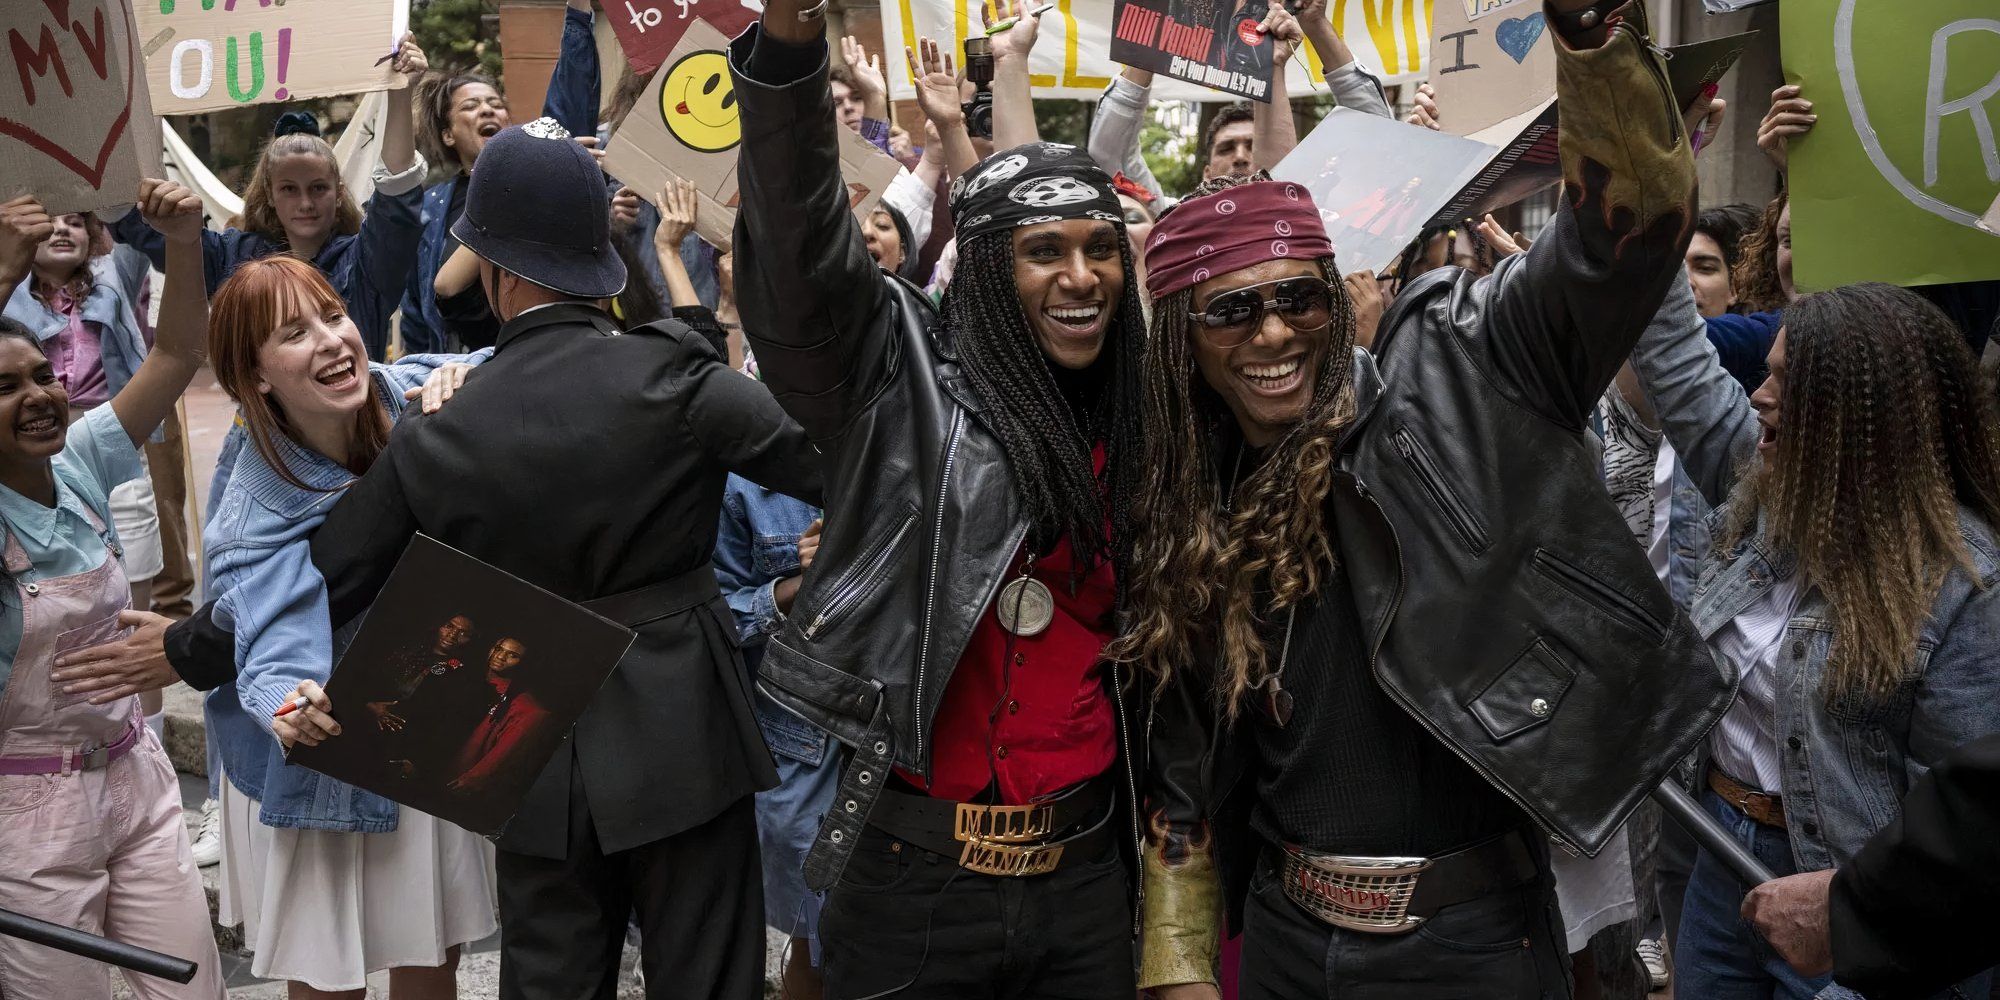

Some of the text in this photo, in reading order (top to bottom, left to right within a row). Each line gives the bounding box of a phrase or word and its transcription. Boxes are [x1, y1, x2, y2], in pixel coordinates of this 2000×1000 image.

[625, 0, 662, 34] to
[8, 6, 108, 106] MV
[1169, 56, 1187, 77] Girl
[1187, 61, 1206, 82] You
[1440, 29, 1480, 75] I
